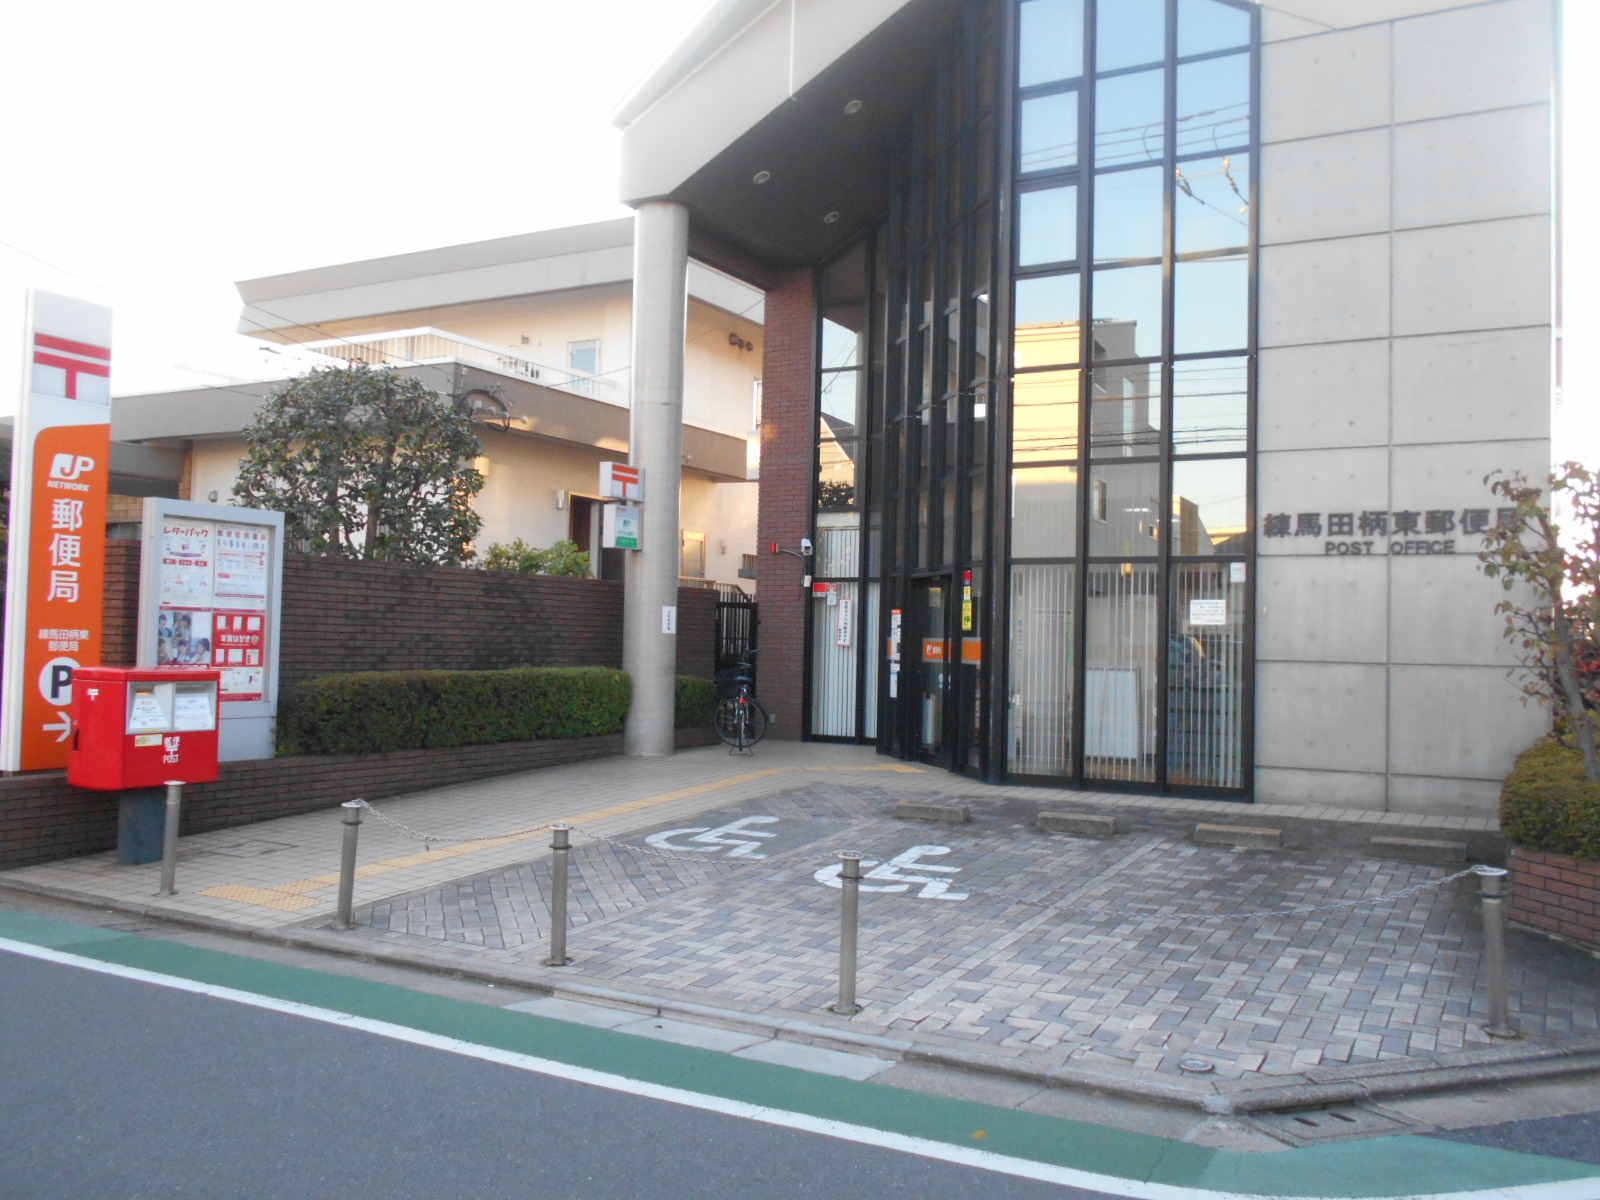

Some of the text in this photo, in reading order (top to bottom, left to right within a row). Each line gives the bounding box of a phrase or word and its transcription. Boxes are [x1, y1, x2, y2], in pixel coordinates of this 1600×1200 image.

[47, 480, 90, 491] NETWORK
[47, 498, 84, 603] 郵便局
[1325, 540, 1455, 555] POST OFFICE
[51, 665, 73, 698] P
[163, 755, 179, 763] POST
